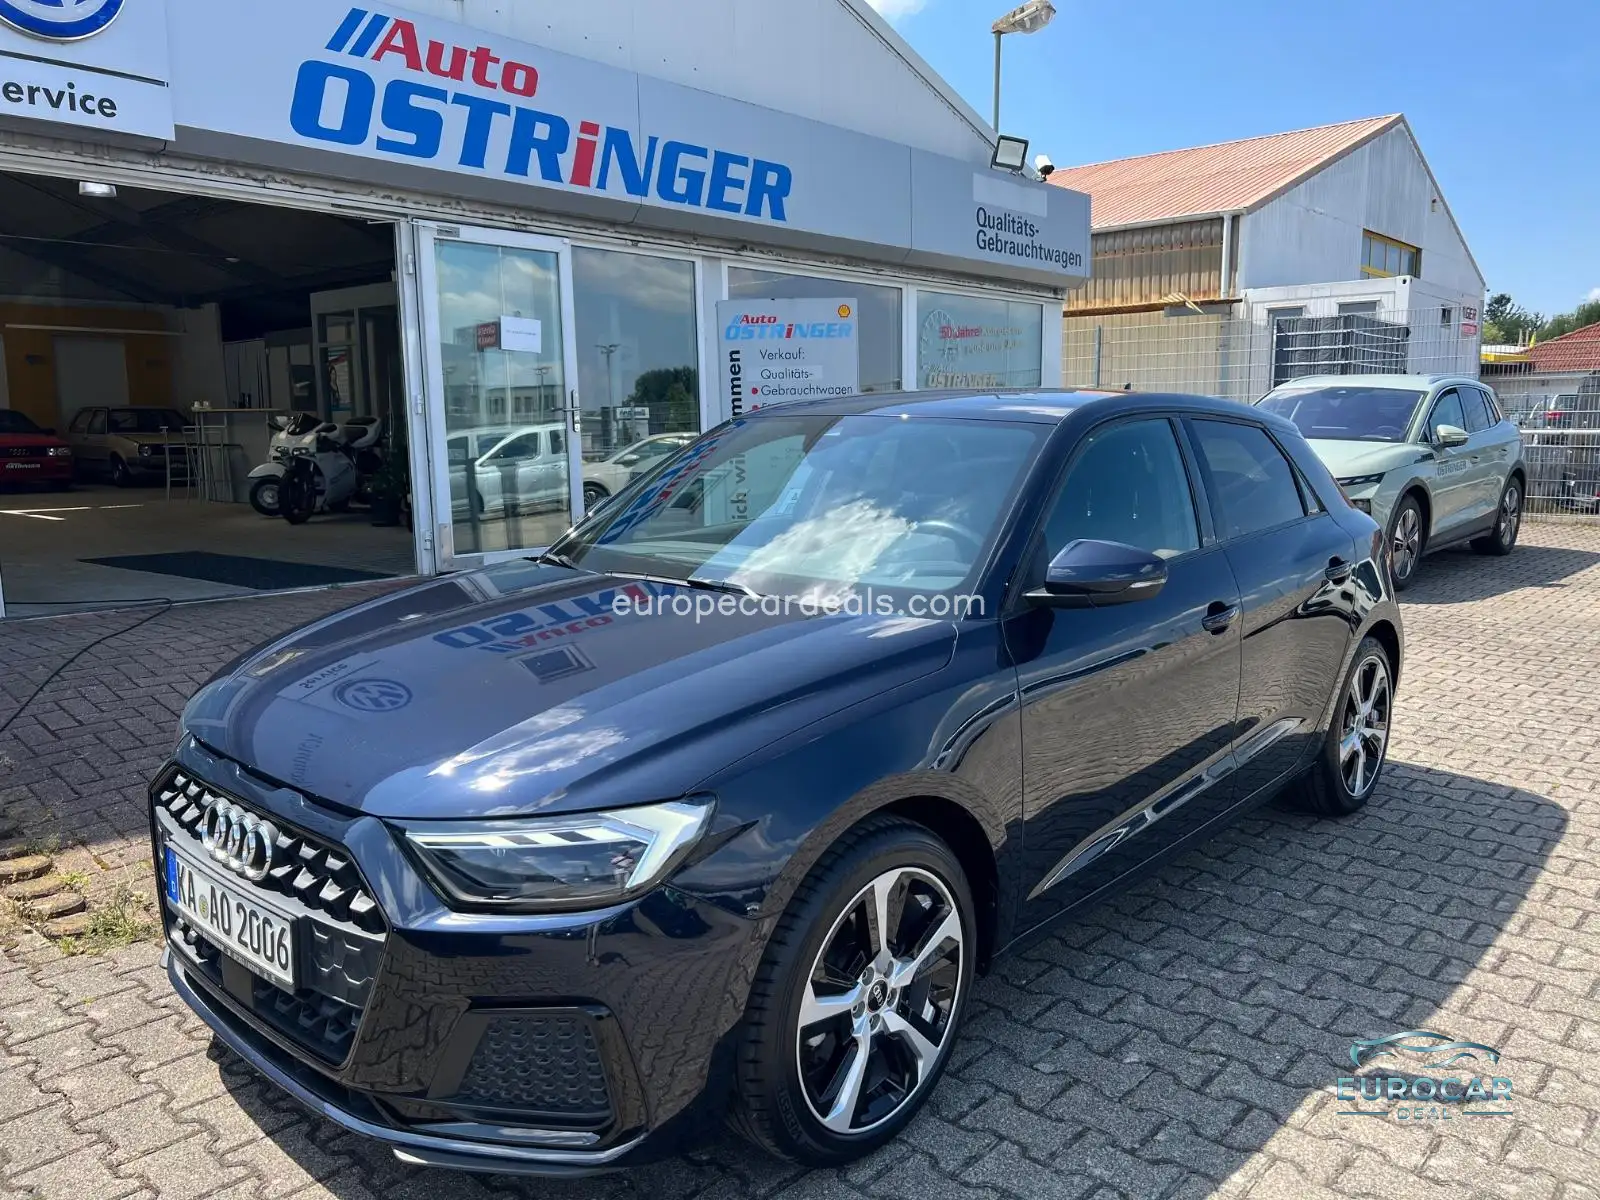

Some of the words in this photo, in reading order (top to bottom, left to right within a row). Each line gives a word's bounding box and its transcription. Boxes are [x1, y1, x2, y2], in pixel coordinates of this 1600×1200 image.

[371, 19, 539, 98] Auto
[976, 206, 1040, 238] Qualitäts-
[976, 229, 1082, 269] Gebrauchtwagen
[740, 314, 777, 324] Auto
[760, 348, 805, 361] Verkauf:
[760, 368, 813, 380] Qualitäts-
[177, 861, 196, 913] KA
[236, 902, 289, 971] 2006
